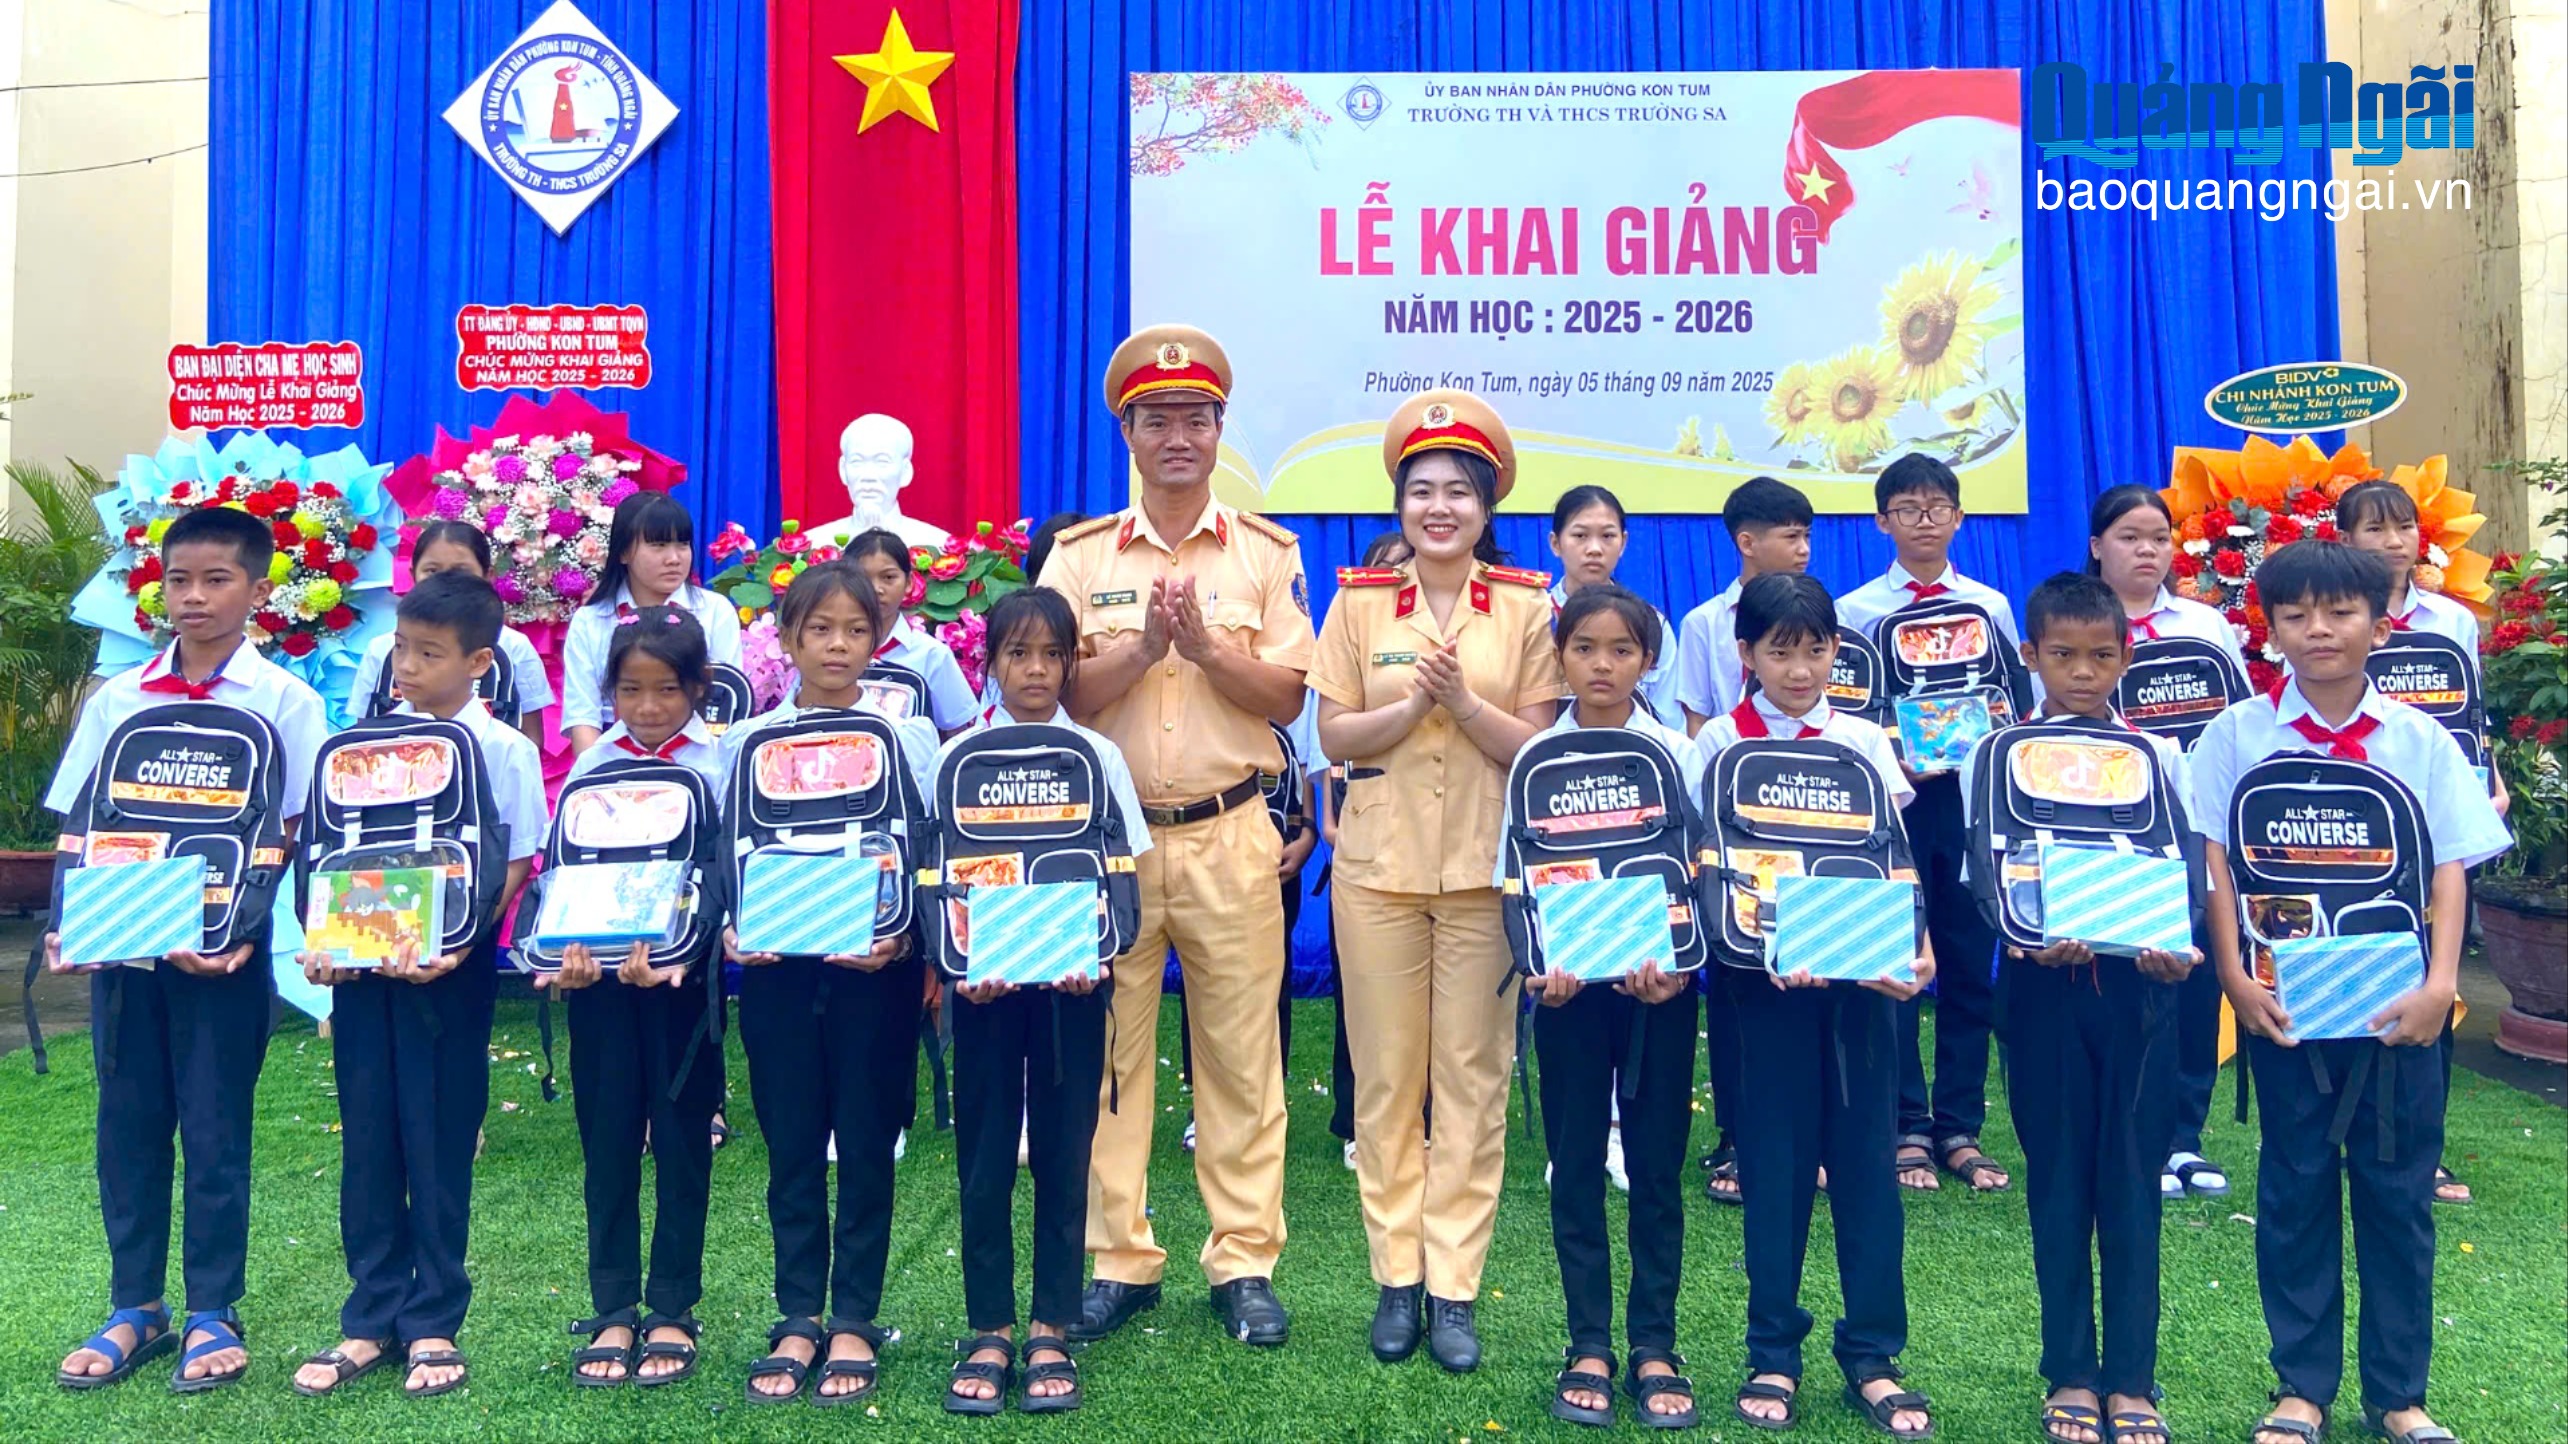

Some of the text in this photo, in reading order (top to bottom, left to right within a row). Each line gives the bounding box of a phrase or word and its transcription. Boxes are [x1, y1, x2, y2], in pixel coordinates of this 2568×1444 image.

[1424, 80, 1710, 97] ỦY BAN NHÂN DÂN PHƯỜNG KON TUM
[1407, 102, 1727, 122] TRƯỜNG TH VÀ THCS TRƯỜNG SA
[1319, 181, 1819, 277] LỄ KHAI GIẢNG
[1384, 293, 1459, 334] NĂM
[1470, 300, 1534, 342] HỌC
[1564, 300, 1642, 334] 2025
[1675, 299, 1753, 334] 2026
[486, 331, 618, 350] PHƯỜNG KON TUM
[174, 349, 357, 382] BAN ĐẠI DIỆN CHA MẸ HỌC SINH
[464, 350, 643, 368] CHÚC MỪNG KHAI GIẢNG
[476, 367, 511, 382] NĂM
[516, 369, 547, 385] HỌC
[552, 369, 585, 382] 2025
[602, 368, 635, 382] 2026
[1481, 371, 1522, 396] Tum,
[1528, 371, 1573, 397] ngày
[1578, 371, 1599, 392] 05
[1604, 370, 1655, 397] tháng
[1661, 371, 1682, 392] 09
[1687, 371, 1725, 392] năm
[1731, 371, 1774, 392] 2025
[2275, 370, 2322, 384] BIDV
[176, 379, 357, 404] Chúc Mừng Lễ Khai Giảng
[2215, 380, 2395, 404] CHI NHÁNH KON TUM
[190, 404, 223, 422] Năm
[228, 404, 255, 425] Học
[259, 403, 295, 421] 2025
[310, 403, 346, 420] 2026
[2391, 665, 2405, 674] ALL
[2150, 676, 2164, 685] ALL
[2377, 674, 2448, 692] CONVERSE
[2137, 680, 2209, 705] CONVERSE
[160, 749, 177, 760] ALL
[137, 760, 232, 788] CONVERSE
[997, 770, 1015, 781] ALL
[1776, 773, 1794, 785] ALL
[979, 781, 1070, 805] CONVERSE
[1565, 779, 1583, 791] ALL
[1549, 785, 1641, 816] CONVERSE
[1758, 783, 1851, 812] CONVERSE
[2284, 807, 2304, 819] ALL
[2266, 820, 2370, 846] CONVERSE
